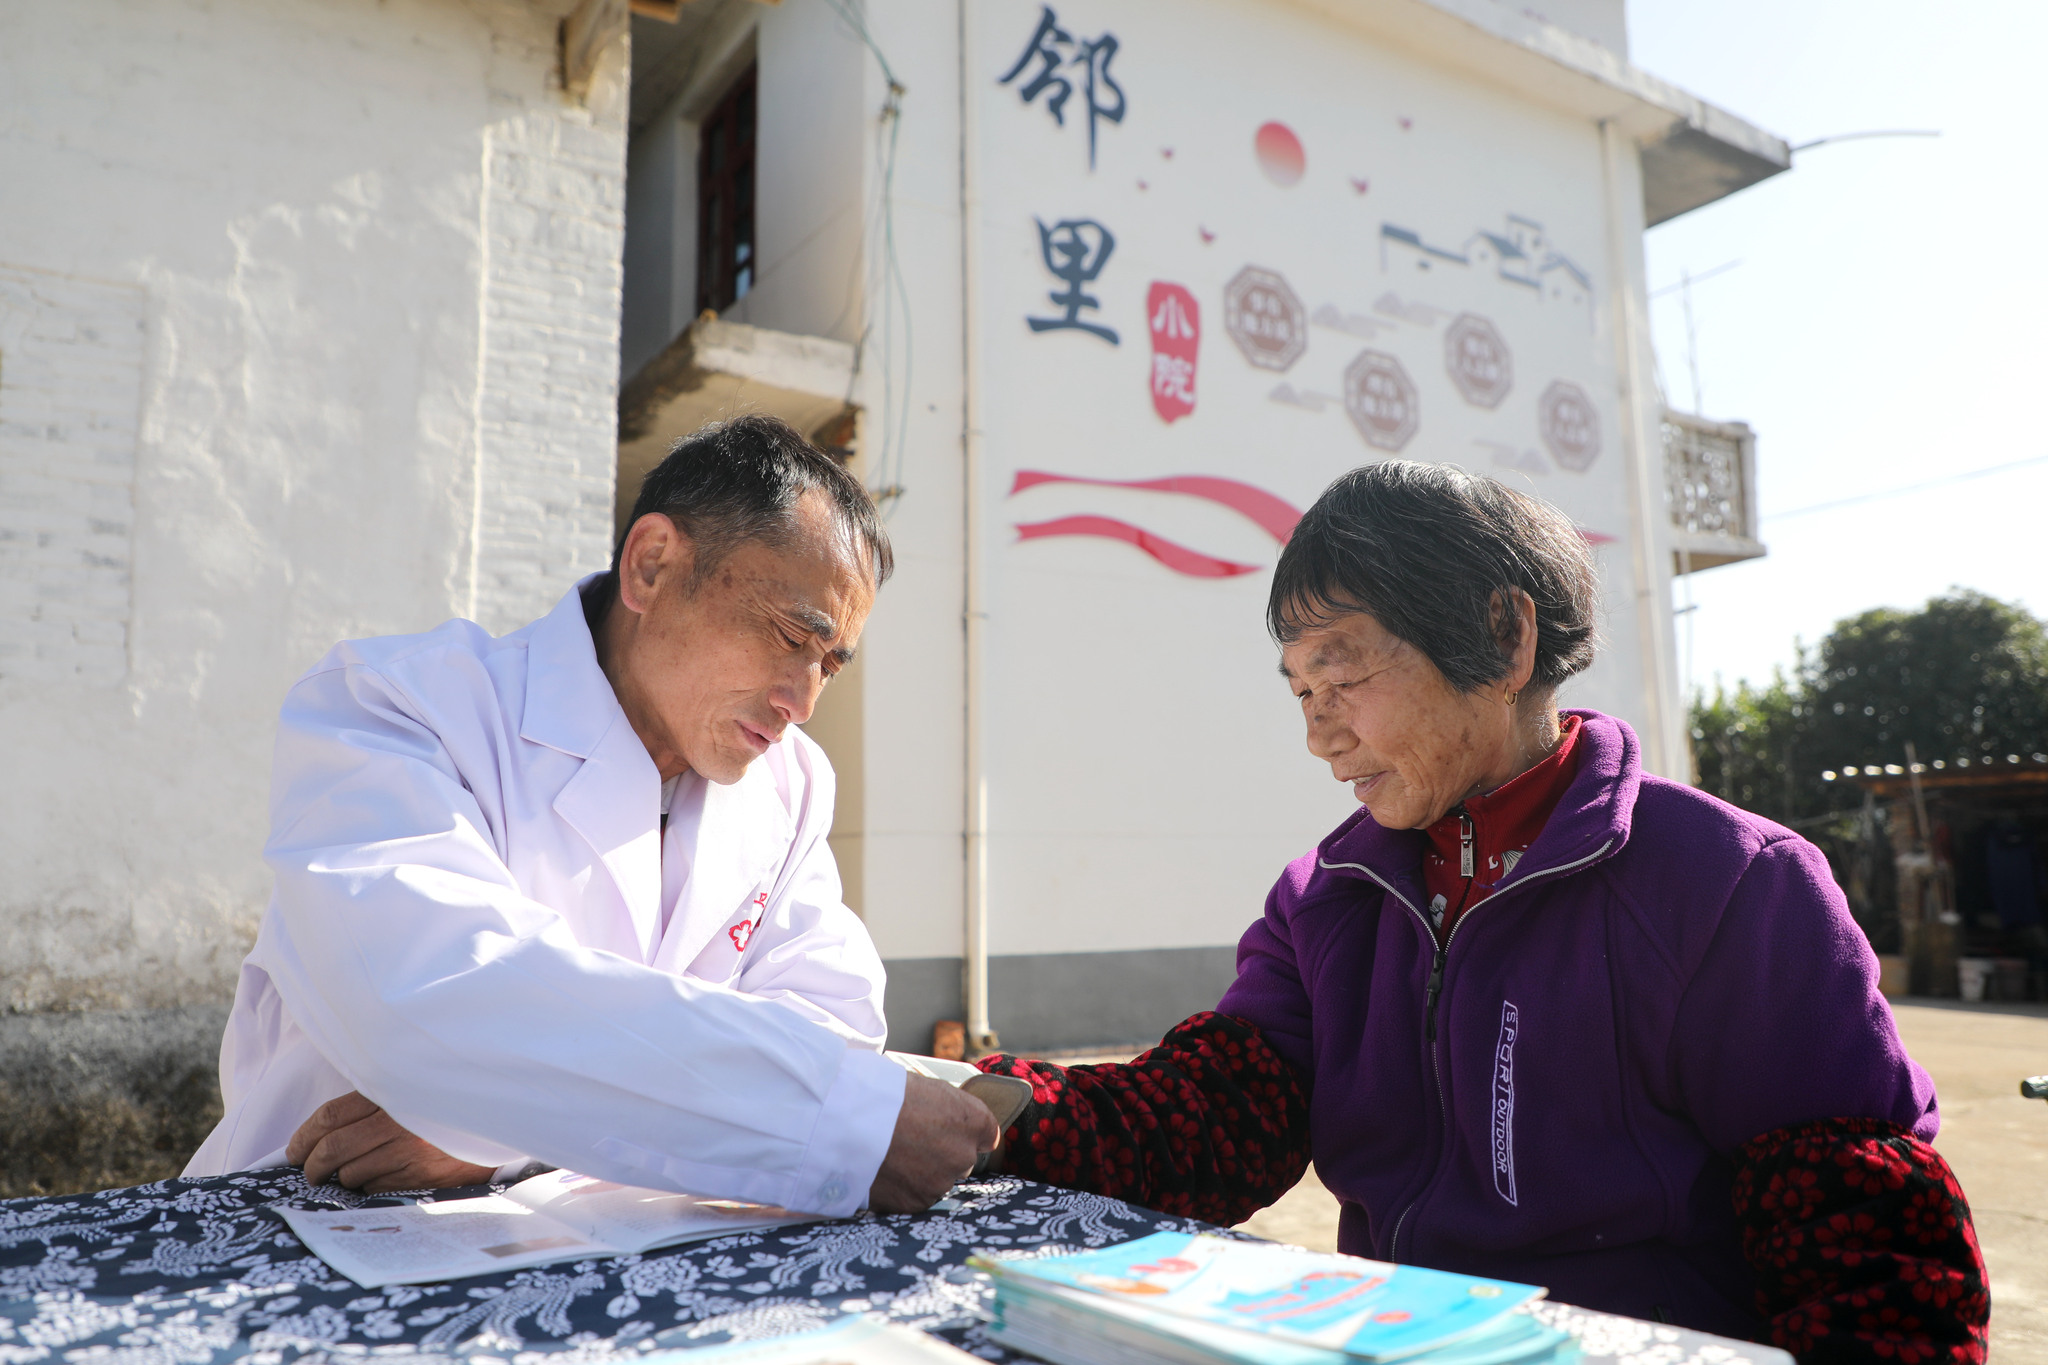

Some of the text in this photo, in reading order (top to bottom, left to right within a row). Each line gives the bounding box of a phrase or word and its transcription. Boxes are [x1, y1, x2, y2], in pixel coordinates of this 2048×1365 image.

[998, 4, 1127, 346] 邻里
[1152, 295, 1196, 402] 小院
[1496, 1011, 1516, 1173] SPORT OUTDOOR
